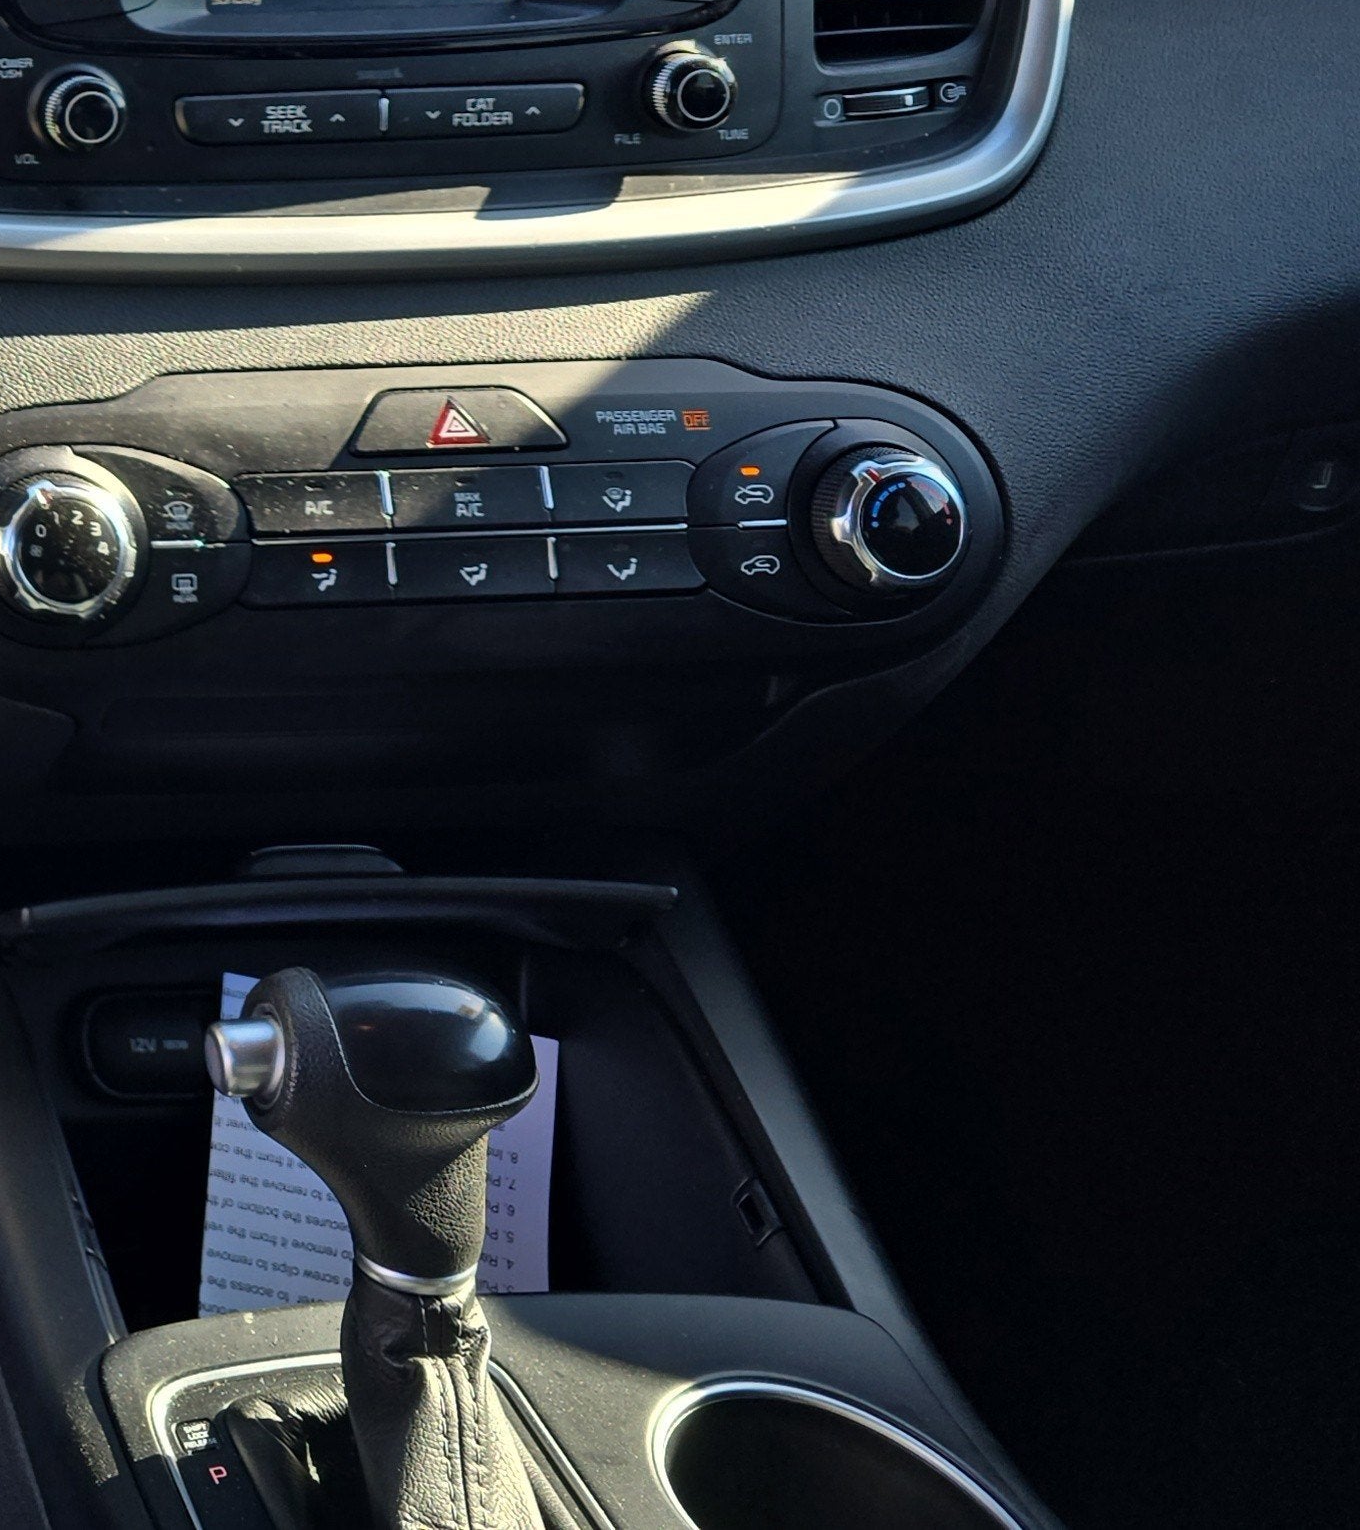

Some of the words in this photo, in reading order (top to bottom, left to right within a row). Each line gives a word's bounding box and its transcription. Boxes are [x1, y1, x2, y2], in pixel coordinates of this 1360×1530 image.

[714, 33, 753, 45] ENTER
[265, 105, 308, 119] SEEK
[465, 97, 497, 112] CAT
[260, 119, 314, 134] TRACK
[452, 111, 514, 127] FOLDER
[613, 132, 642, 145] FILE
[717, 128, 749, 141] TUNE
[14, 154, 40, 165] VOL
[595, 409, 678, 424] PASSENGER
[683, 412, 711, 428] OFF
[612, 422, 638, 436] AIR
[639, 422, 668, 435] BAG
[305, 500, 335, 516] A/C
[455, 502, 485, 518] A/C
[53, 511, 62, 527] 1
[71, 510, 84, 526] 2
[35, 524, 47, 538] 0
[90, 522, 102, 537] 3
[98, 542, 110, 556] 4
[233, 1148, 253, 1160] the
[239, 1173, 260, 1188] the
[262, 1178, 308, 1197] remove
[310, 1188, 323, 1201] to
[220, 1197, 235, 1209] of
[237, 1200, 280, 1219] bottom
[282, 1209, 302, 1223] the
[226, 1225, 247, 1239] the
[250, 1230, 278, 1247] from
[291, 1239, 338, 1257] remove
[206, 1247, 253, 1267] remove
[255, 1258, 268, 1271] to
[271, 1262, 301, 1278] clips
[303, 1269, 341, 1286] screw
[206, 1275, 228, 1290] the
[230, 1279, 275, 1298] access
[276, 1290, 289, 1303] to
[209, 1466, 227, 1485] P
